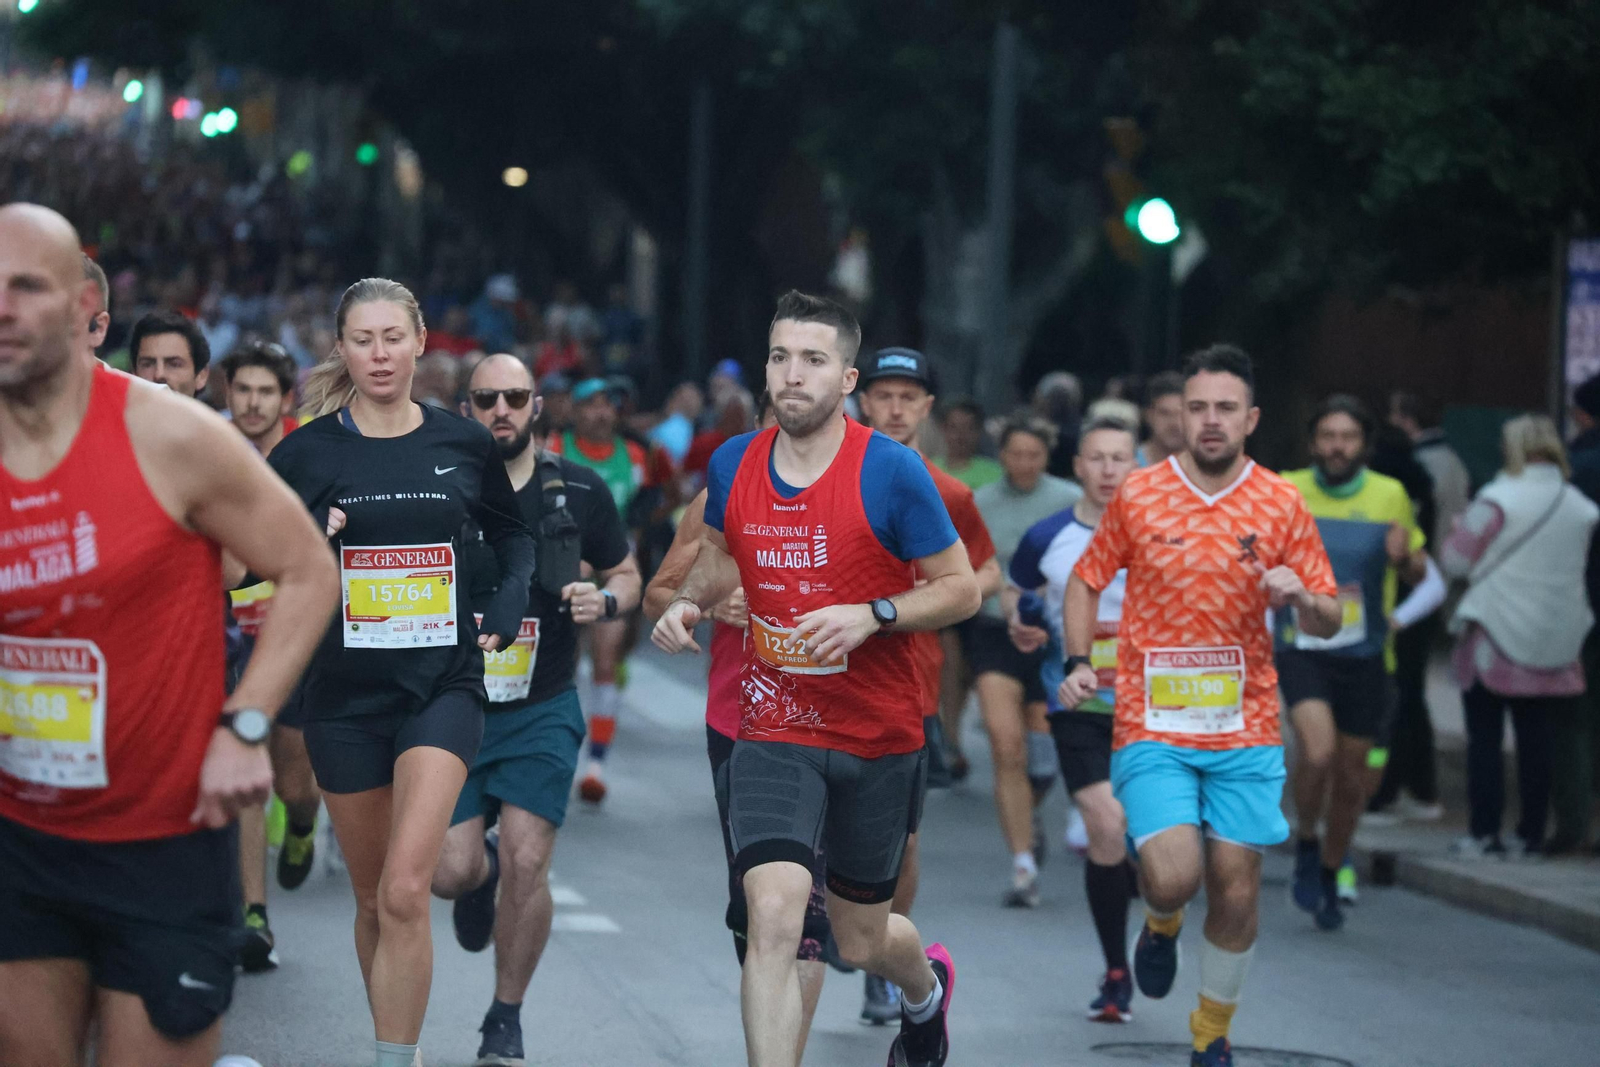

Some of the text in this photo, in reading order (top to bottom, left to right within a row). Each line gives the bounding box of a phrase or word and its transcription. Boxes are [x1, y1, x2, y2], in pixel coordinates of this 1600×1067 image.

[773, 502, 799, 511] luanvi
[757, 524, 809, 537] GENERALI
[782, 542, 809, 550] MARATÓN
[374, 550, 446, 567] GENERALI
[756, 547, 811, 568] MÁLAGA
[368, 583, 433, 602] 15764
[422, 622, 440, 630] 21K
[777, 655, 808, 663] ALFREDO
[1172, 650, 1236, 666] GENERALI
[1168, 678, 1224, 695] 13190
